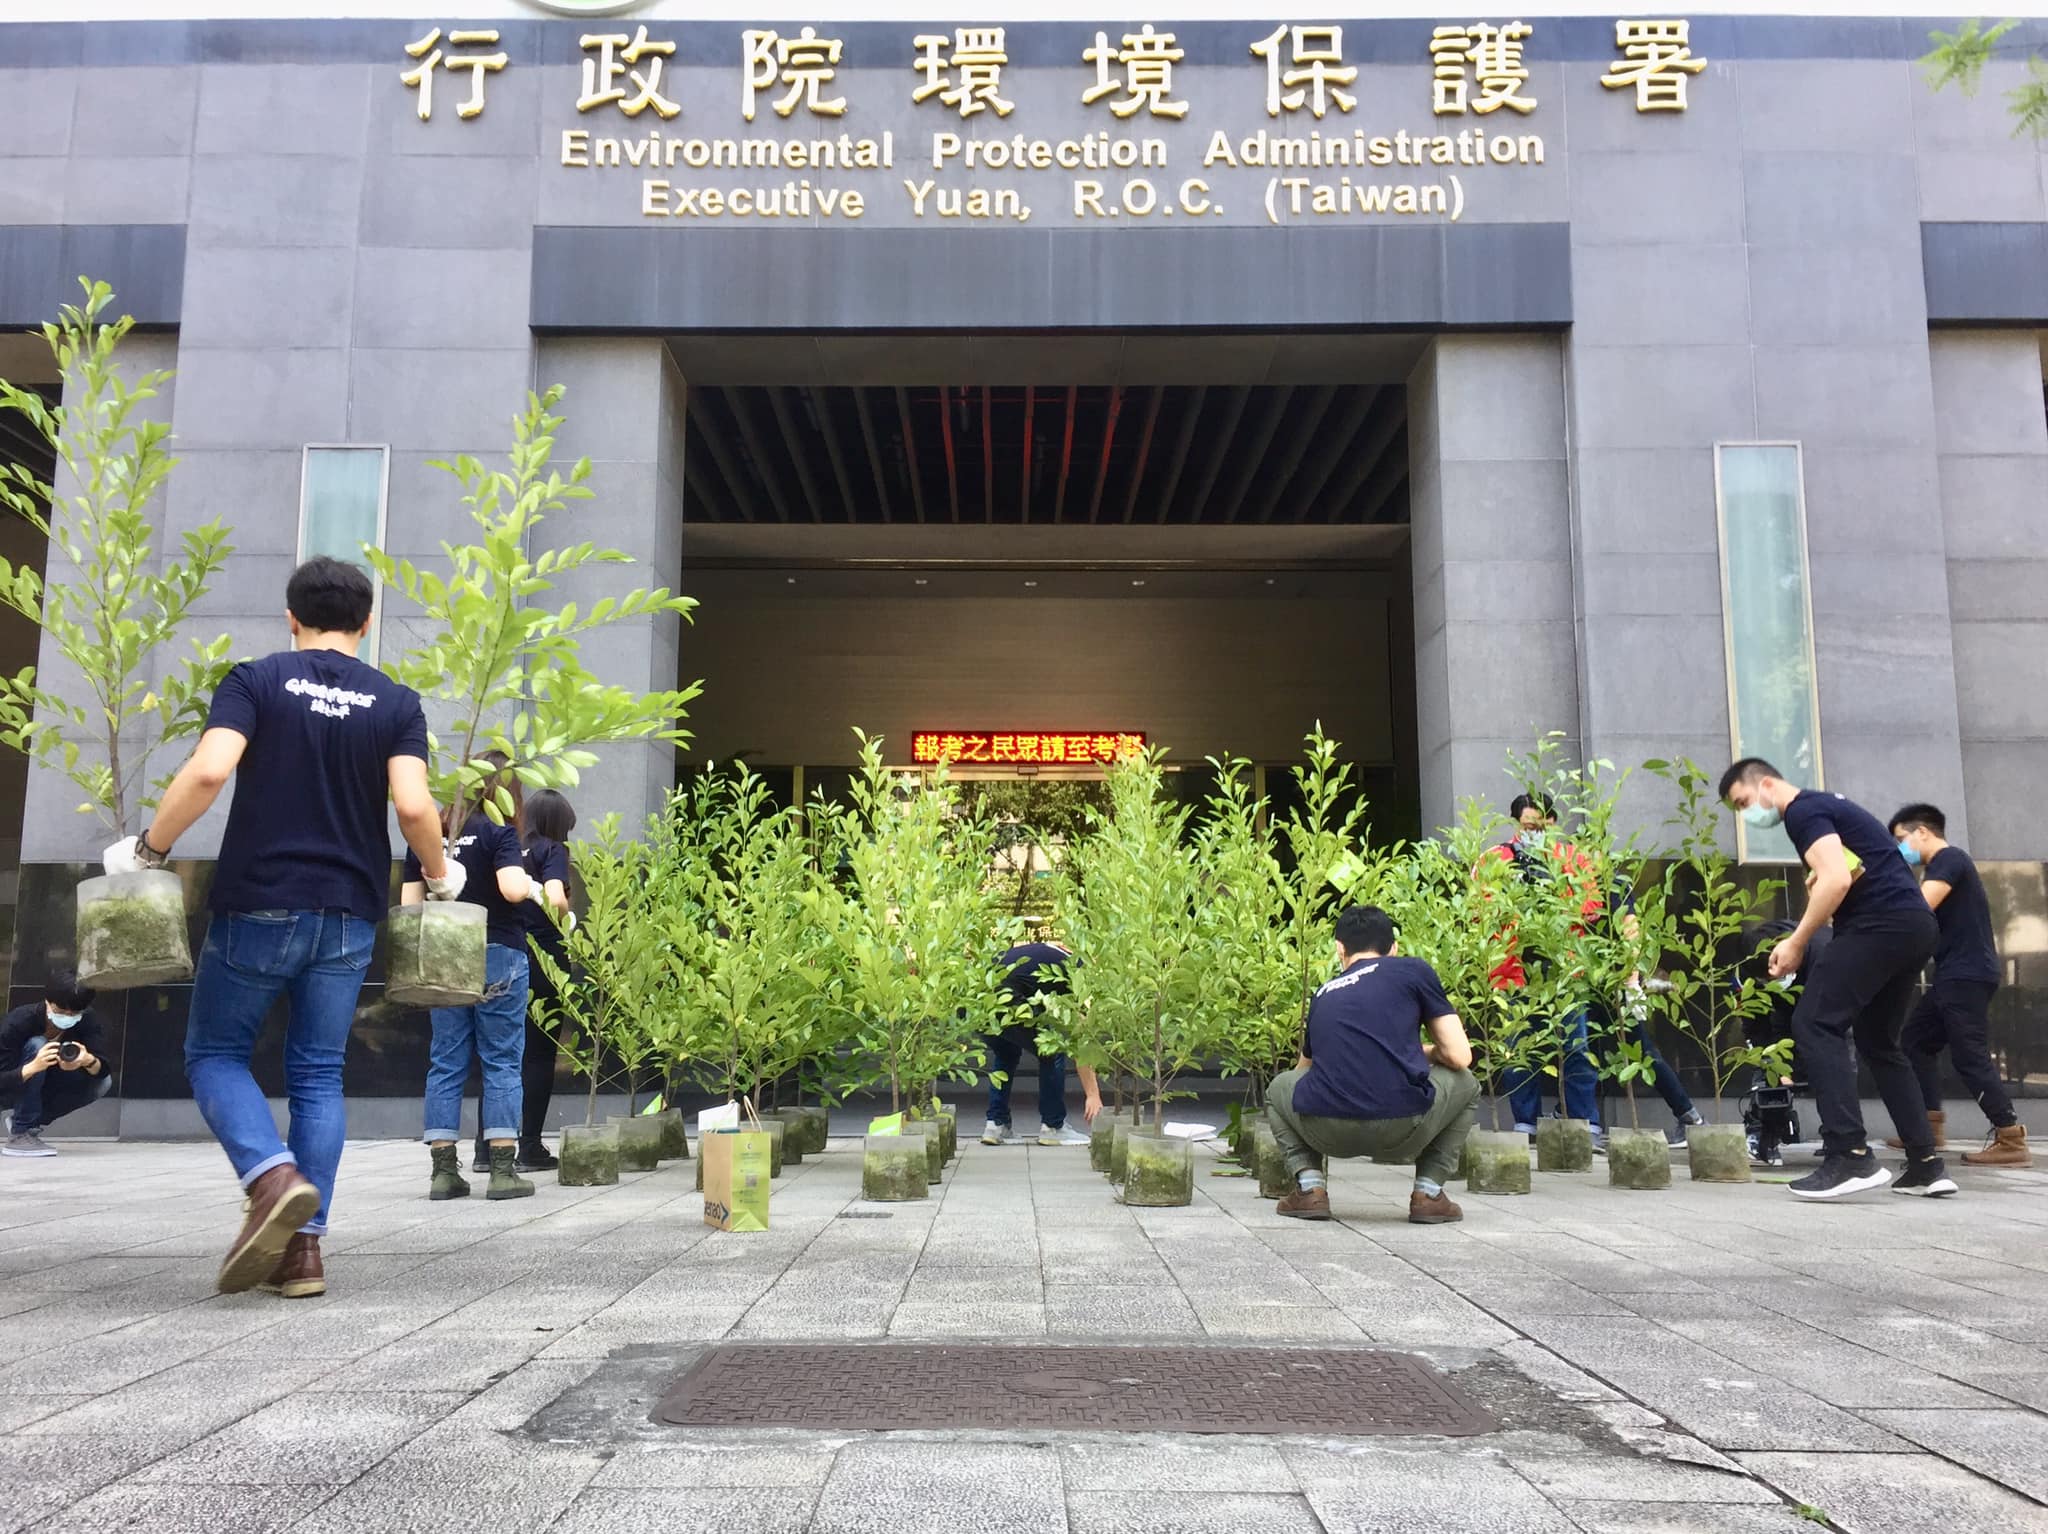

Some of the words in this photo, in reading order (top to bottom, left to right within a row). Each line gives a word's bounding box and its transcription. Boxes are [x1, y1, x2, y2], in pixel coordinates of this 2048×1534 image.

[400, 19, 1707, 122] 行政院環境保護署
[561, 129, 893, 169] Environmental
[932, 131, 1167, 169] Protection
[1203, 128, 1545, 167] Administration
[641, 179, 865, 218] Executive
[904, 179, 1032, 221] Yuan,
[1073, 178, 1224, 217] R.O.C.
[1265, 175, 1465, 224] (Taiwan)
